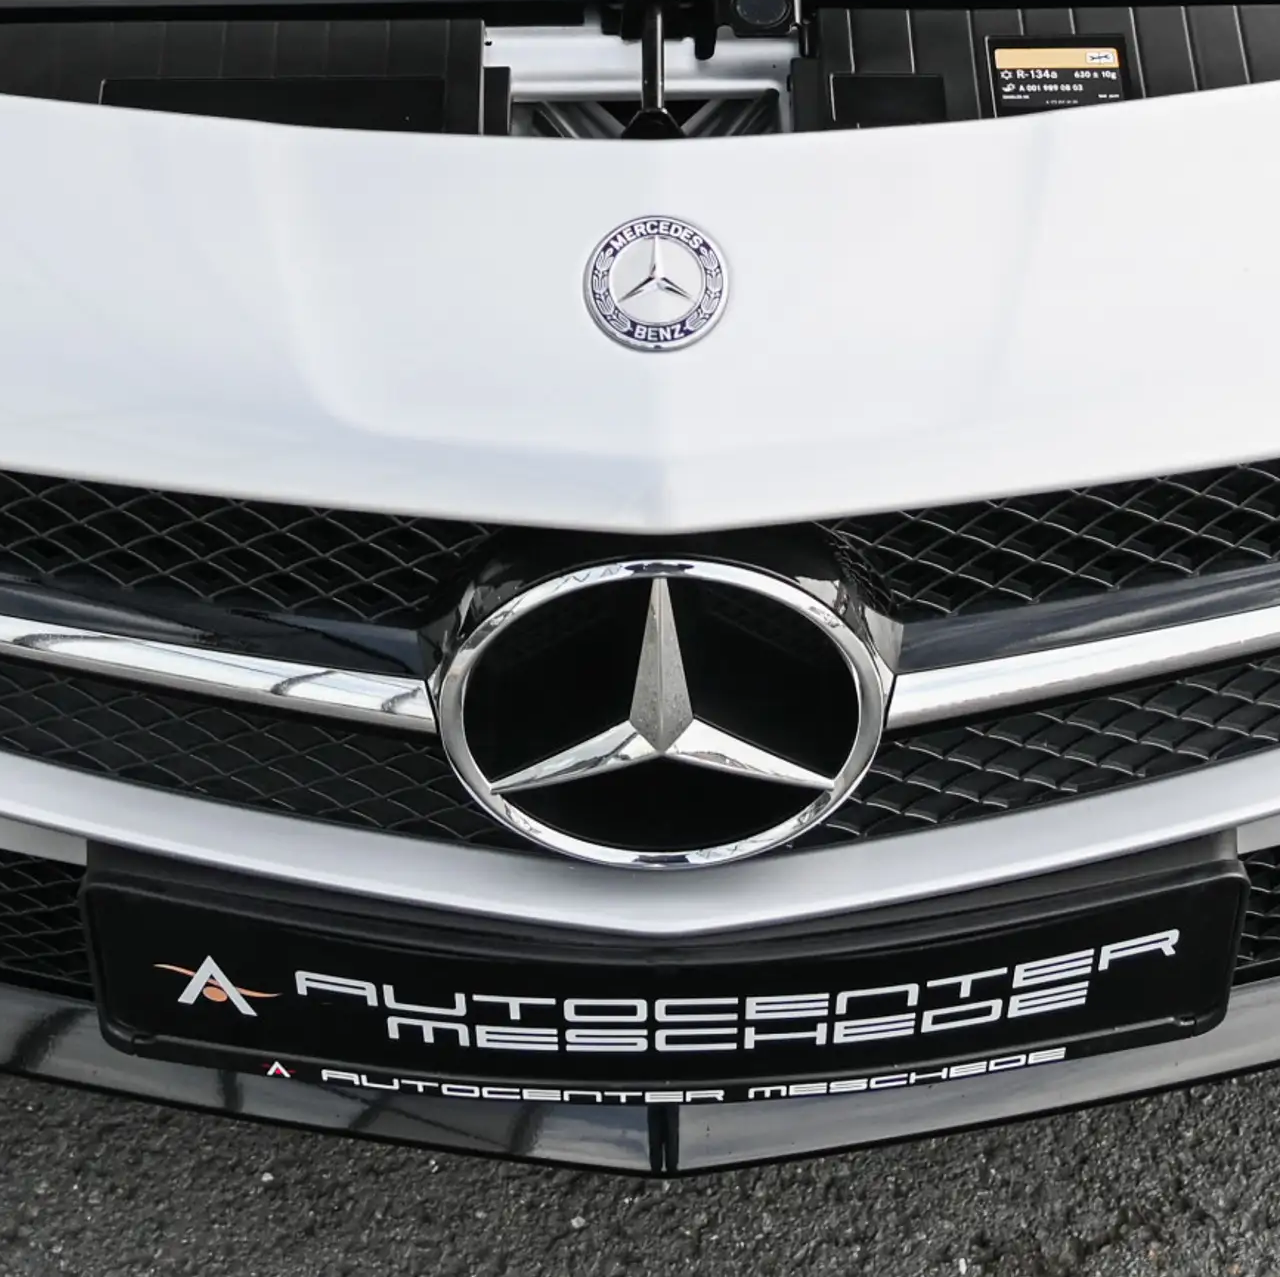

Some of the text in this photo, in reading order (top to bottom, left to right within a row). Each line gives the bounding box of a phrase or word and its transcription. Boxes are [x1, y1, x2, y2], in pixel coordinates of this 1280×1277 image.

[609, 221, 704, 251] MERCEDES
[634, 324, 684, 341] BENZ
[295, 928, 1179, 1022] AUTOCENTER
[387, 980, 1089, 1052] MESCHEDE
[321, 1047, 1066, 1103] AUTOCENTER MESCHEDE
